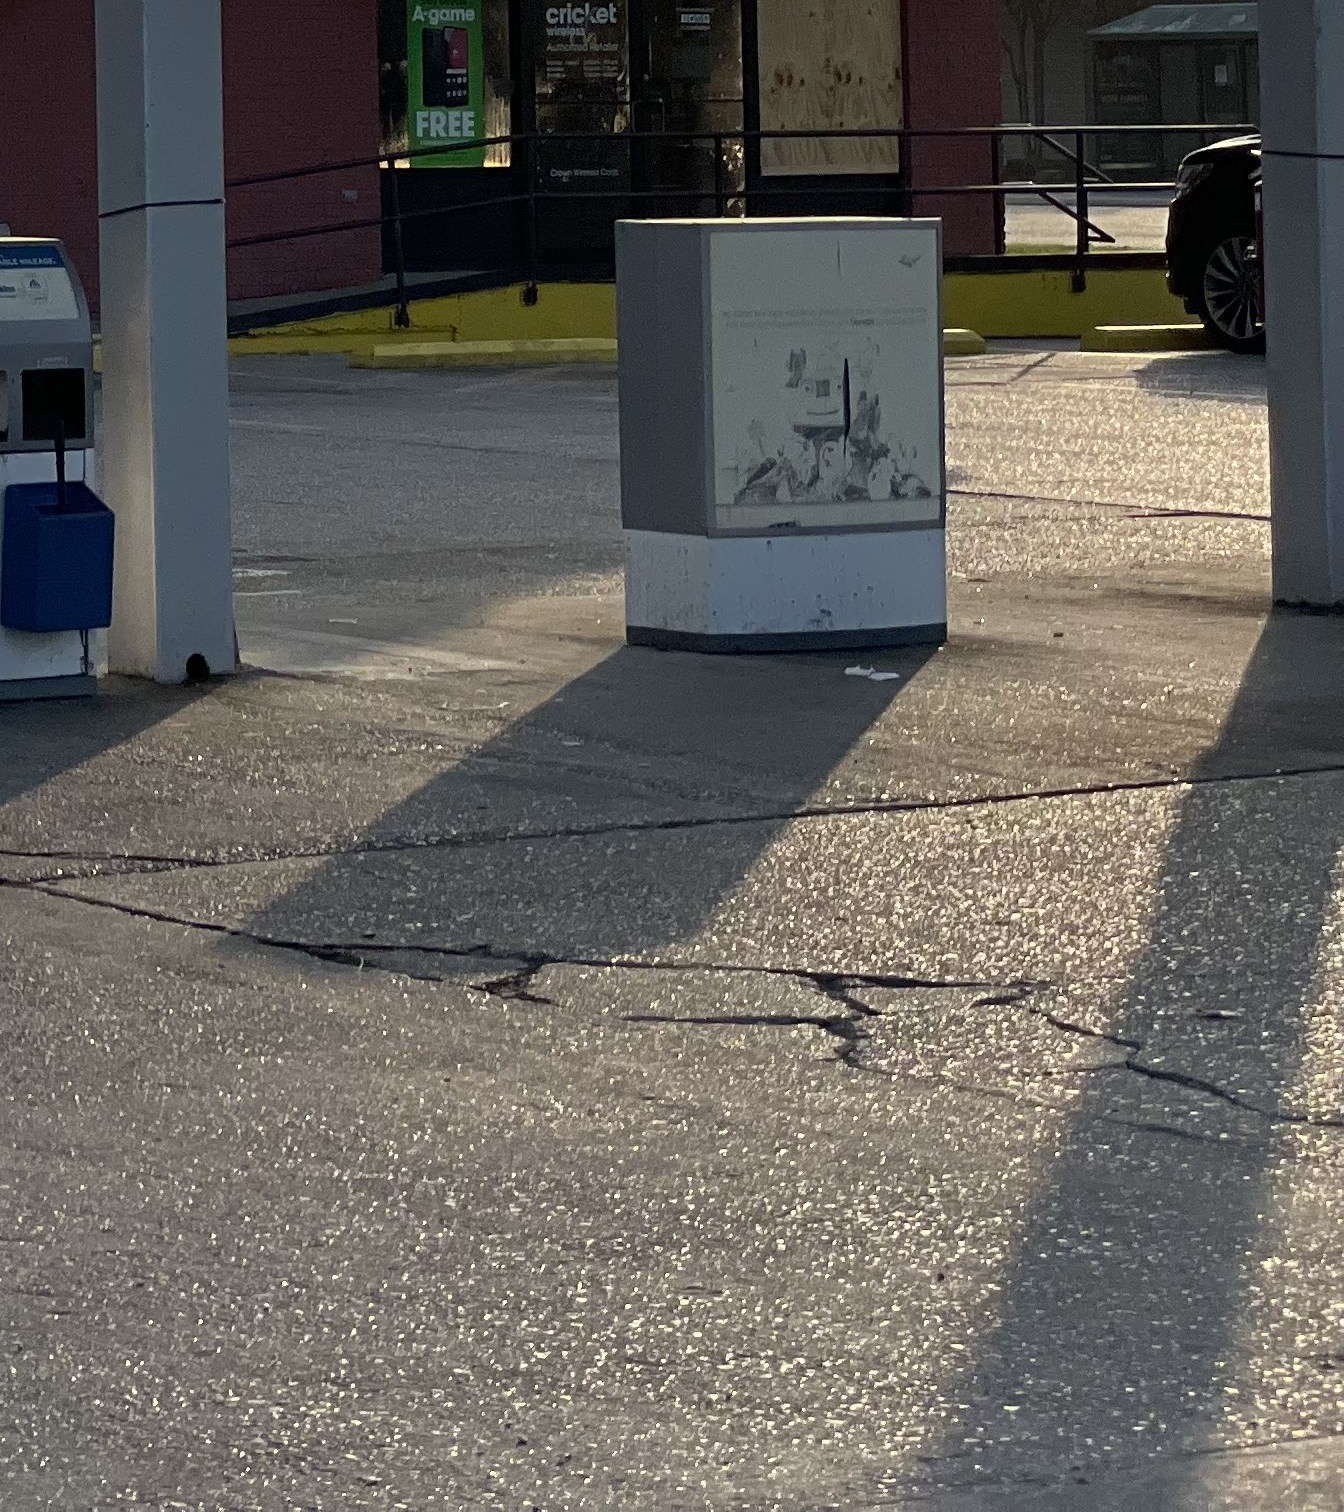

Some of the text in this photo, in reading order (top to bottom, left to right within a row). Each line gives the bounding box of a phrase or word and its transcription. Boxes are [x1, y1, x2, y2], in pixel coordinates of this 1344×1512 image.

[411, 5, 475, 25] A-game
[546, 2, 617, 25] cricket
[416, 110, 475, 139] FREE
